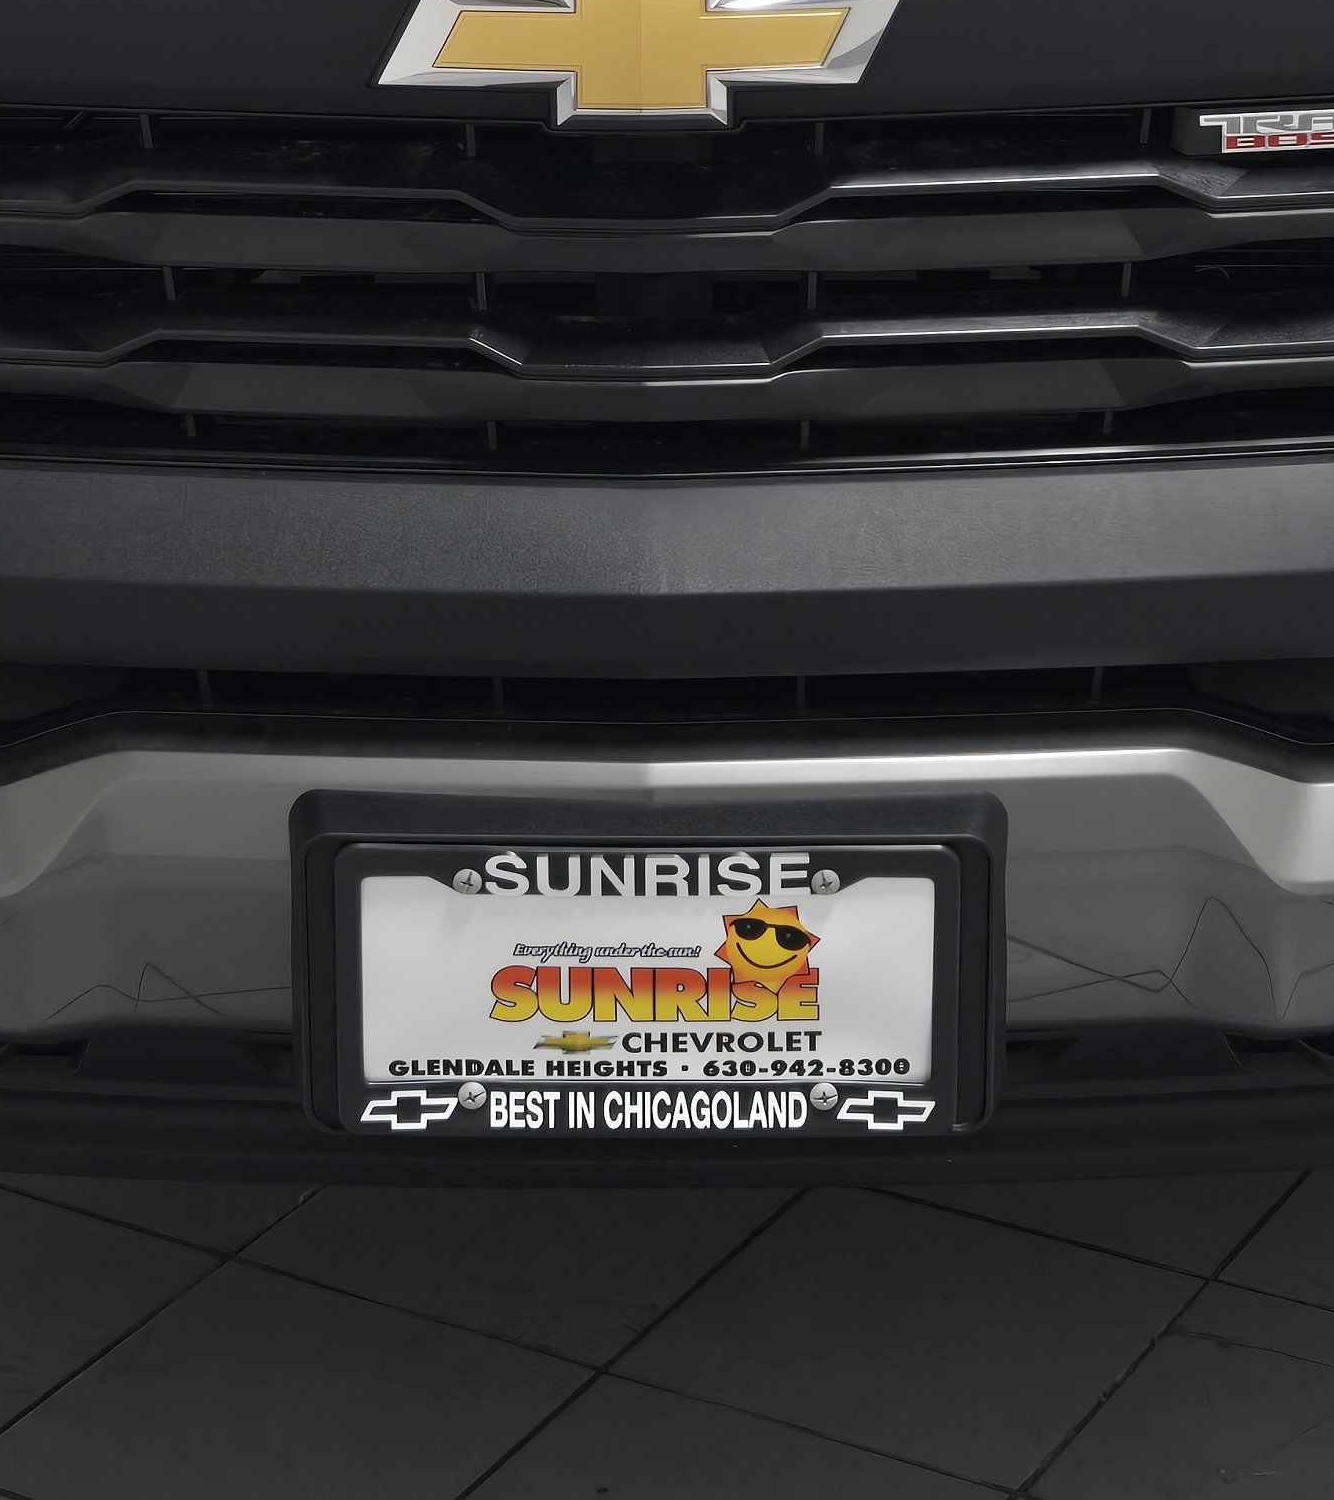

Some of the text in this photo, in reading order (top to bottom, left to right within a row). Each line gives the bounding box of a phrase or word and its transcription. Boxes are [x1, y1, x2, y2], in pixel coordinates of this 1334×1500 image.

[485, 851, 812, 897] SUNRISE
[513, 941, 702, 964] Everything under the sun!
[489, 964, 820, 1022] SUNRISE
[621, 1031, 823, 1053] CHEVROLET
[388, 1058, 911, 1077] GLENDALE HEIGHTS 630-942-8300
[489, 1090, 808, 1130] BEST IN CHICAGOLAND
